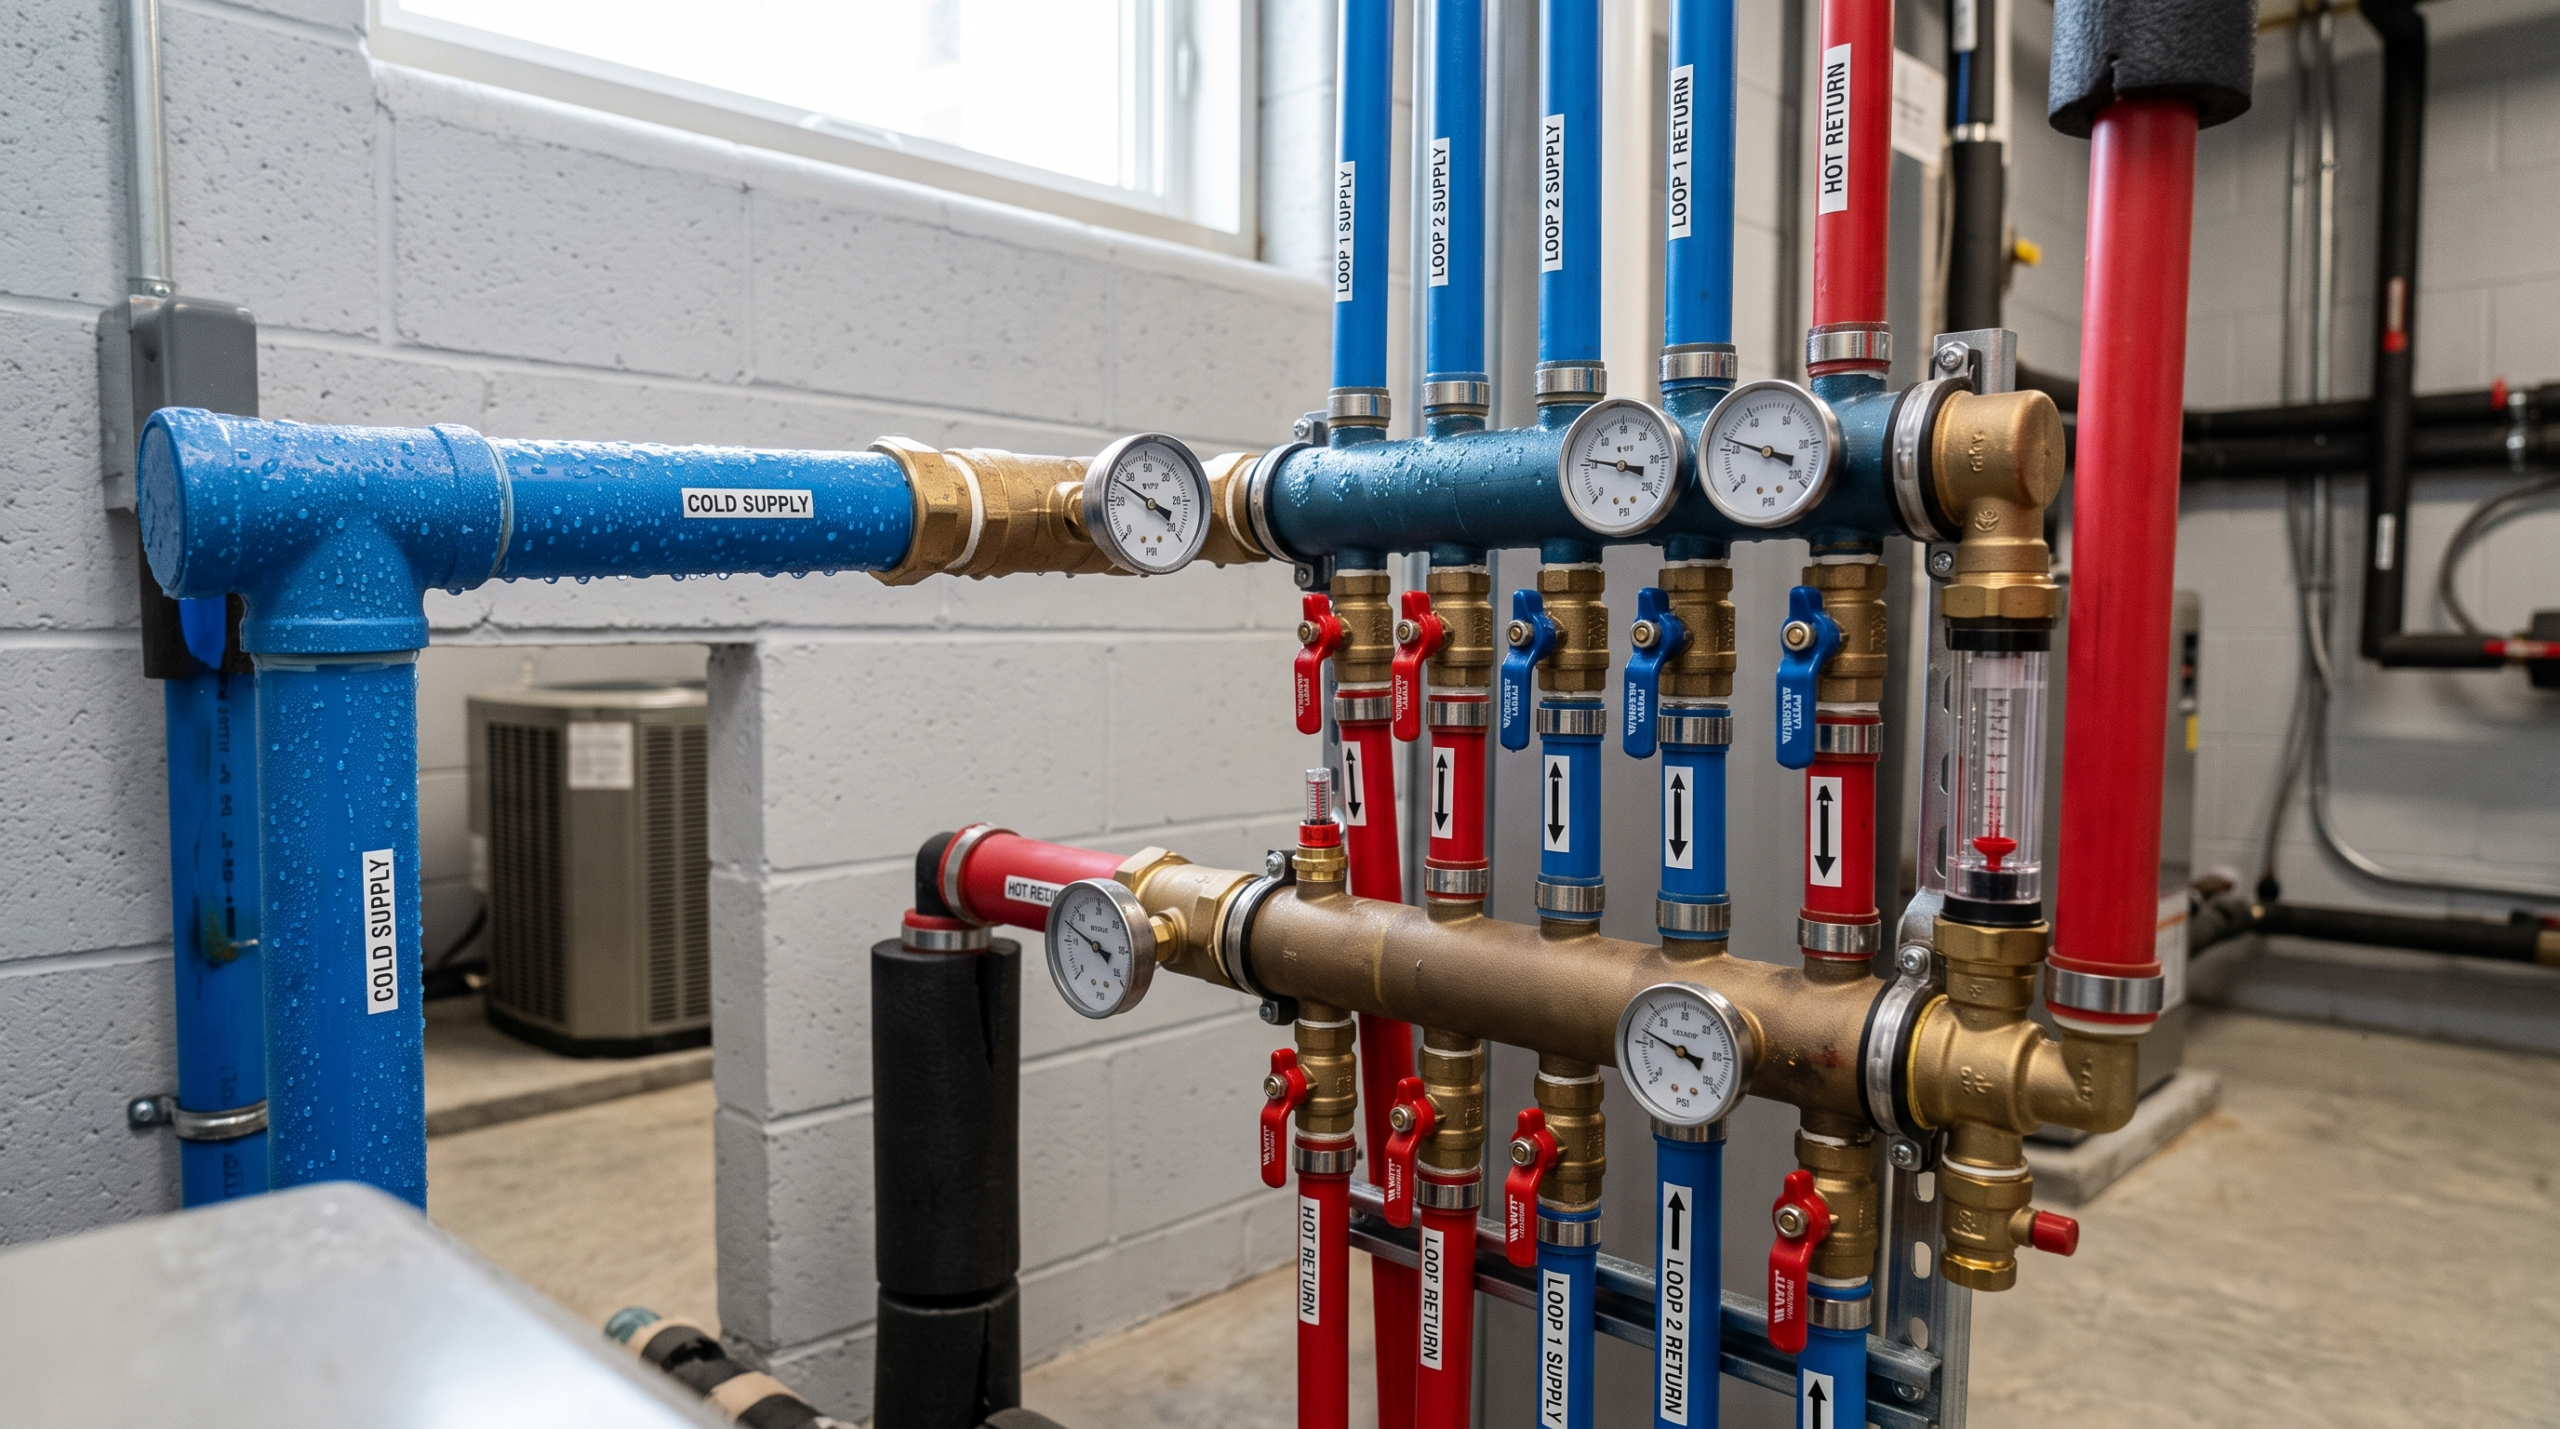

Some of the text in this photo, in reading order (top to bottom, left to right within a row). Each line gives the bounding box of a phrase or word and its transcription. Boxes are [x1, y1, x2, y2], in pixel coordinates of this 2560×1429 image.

[1671, 76, 1689, 228] LOOP 1 RETURN
[1824, 62, 1845, 194] HOT RETURN
[1340, 171, 1351, 231] SUPPLY
[1432, 148, 1446, 277] LOOP 2 SUPPLY
[1544, 125, 1560, 262] LOOP 2 SUPPLY
[1338, 251, 1350, 292] LOOP
[688, 494, 808, 513] COLD SUPPLY
[1619, 508, 1630, 516] PSI
[369, 859, 394, 1002] COLD SUPPLY
[1008, 881, 1028, 898] HOT
[1676, 1097, 1689, 1108] PSI
[1302, 1205, 1316, 1316] HOT RETURN
[1423, 1288, 1438, 1360] RETURN
[1546, 1277, 1564, 1424] LOOP 1 SUPPLY
[1665, 1258, 1684, 1415] LOOP 2 RETURN
